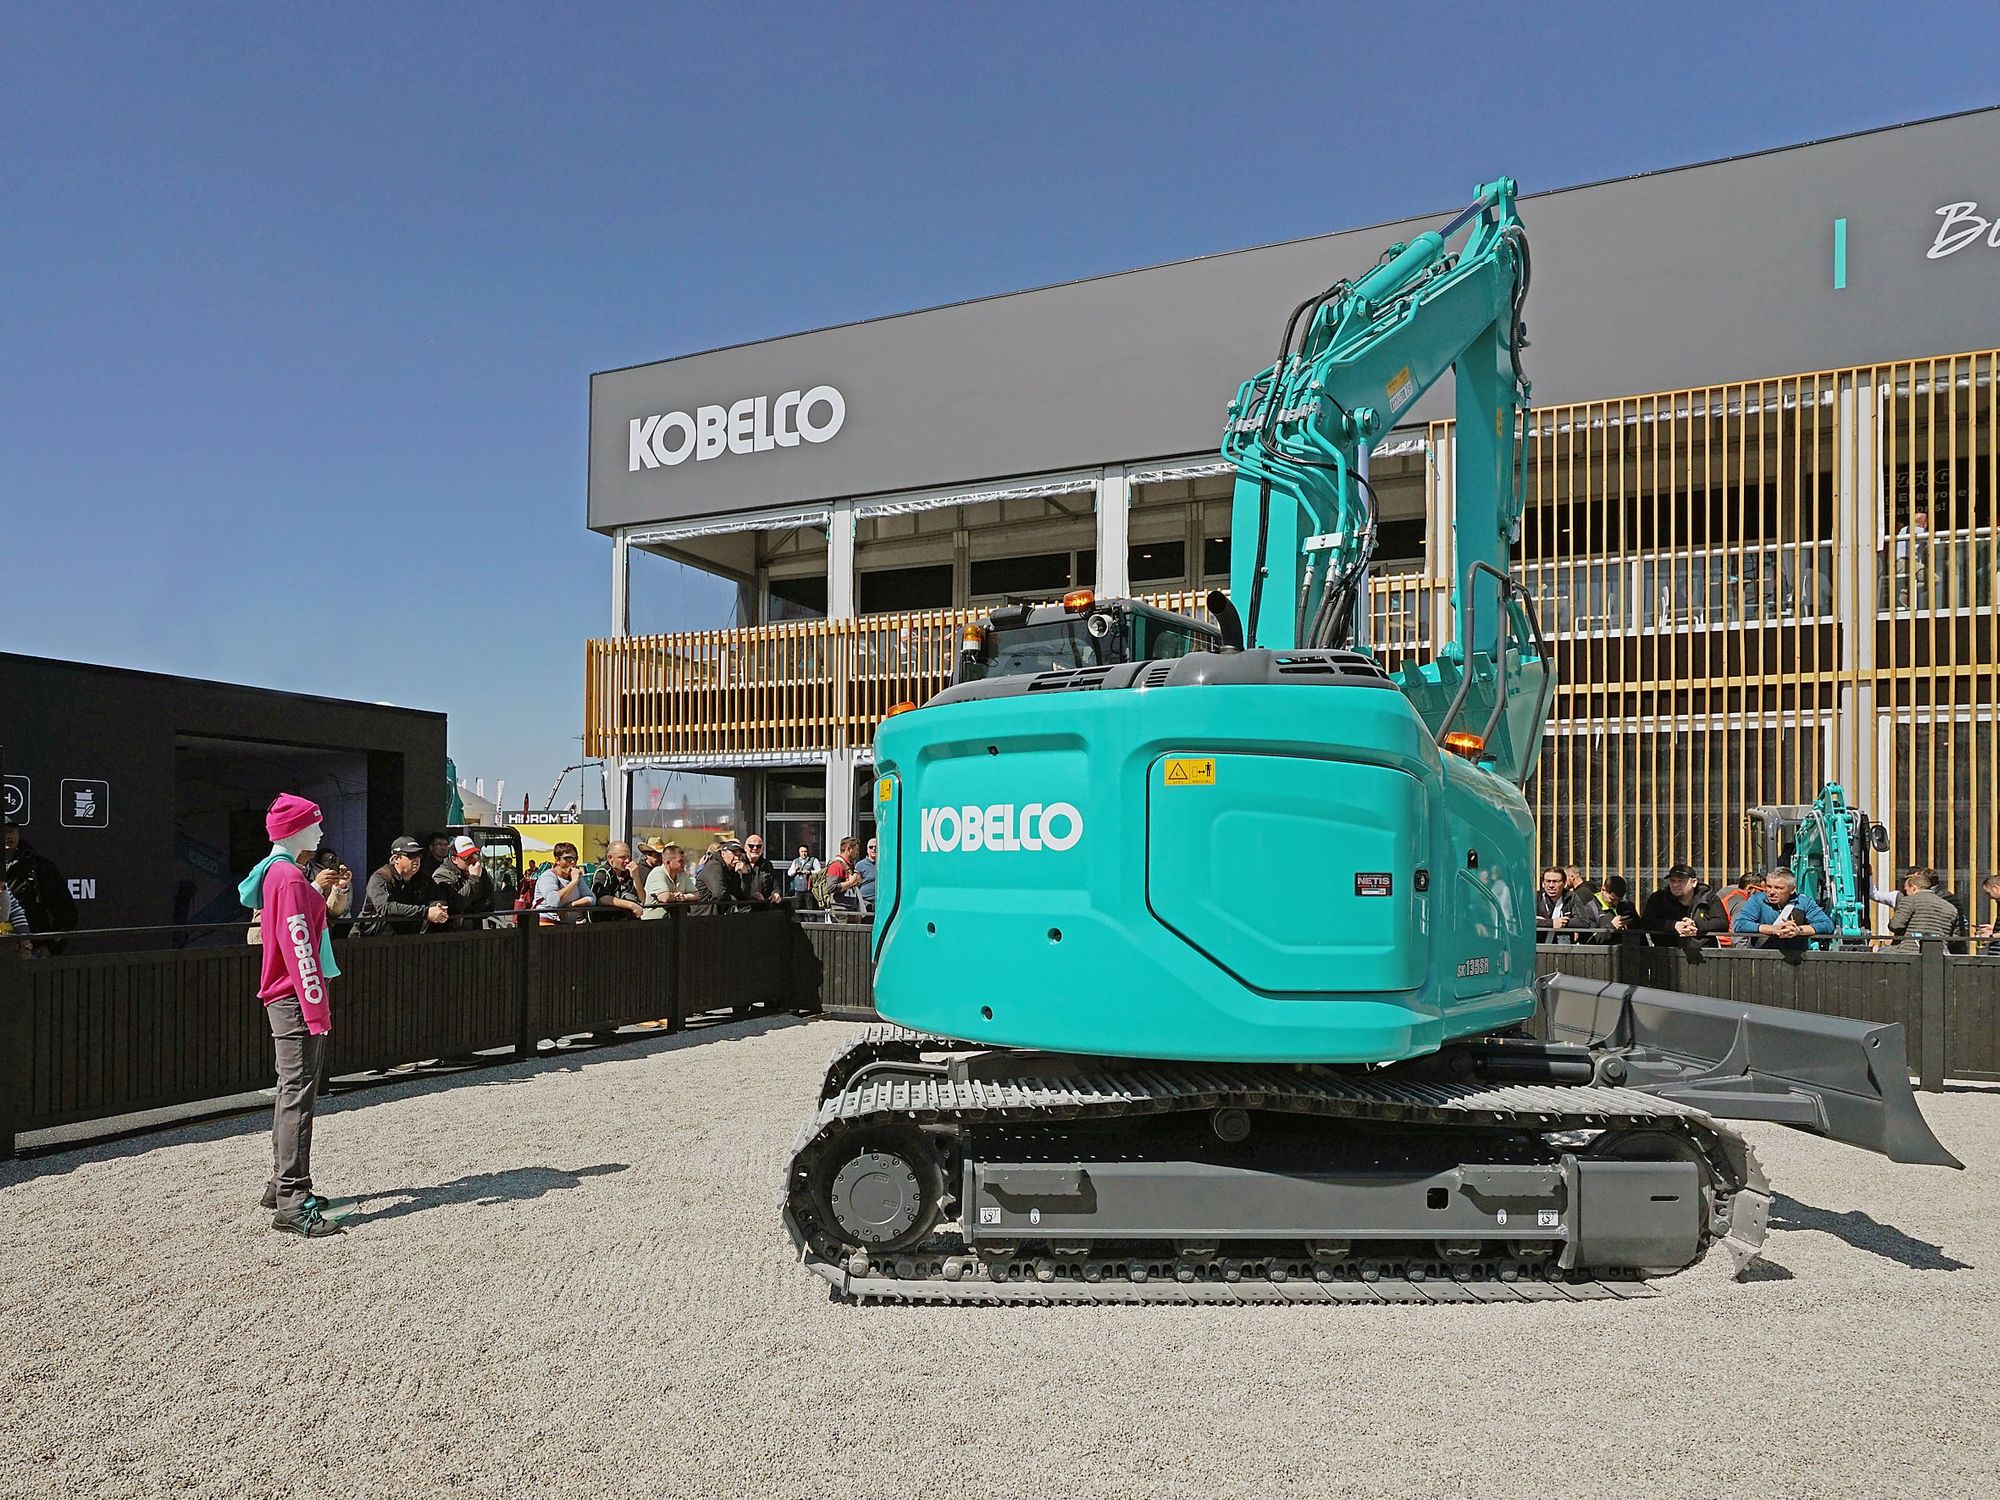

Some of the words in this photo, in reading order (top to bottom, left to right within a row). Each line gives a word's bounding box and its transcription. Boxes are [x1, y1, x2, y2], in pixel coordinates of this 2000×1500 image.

[628, 385, 846, 472] KOBELCO
[920, 802, 1084, 853] KOBELCO
[1357, 877, 1390, 885] NETIS
[286, 913, 323, 1005] KOBELCO
